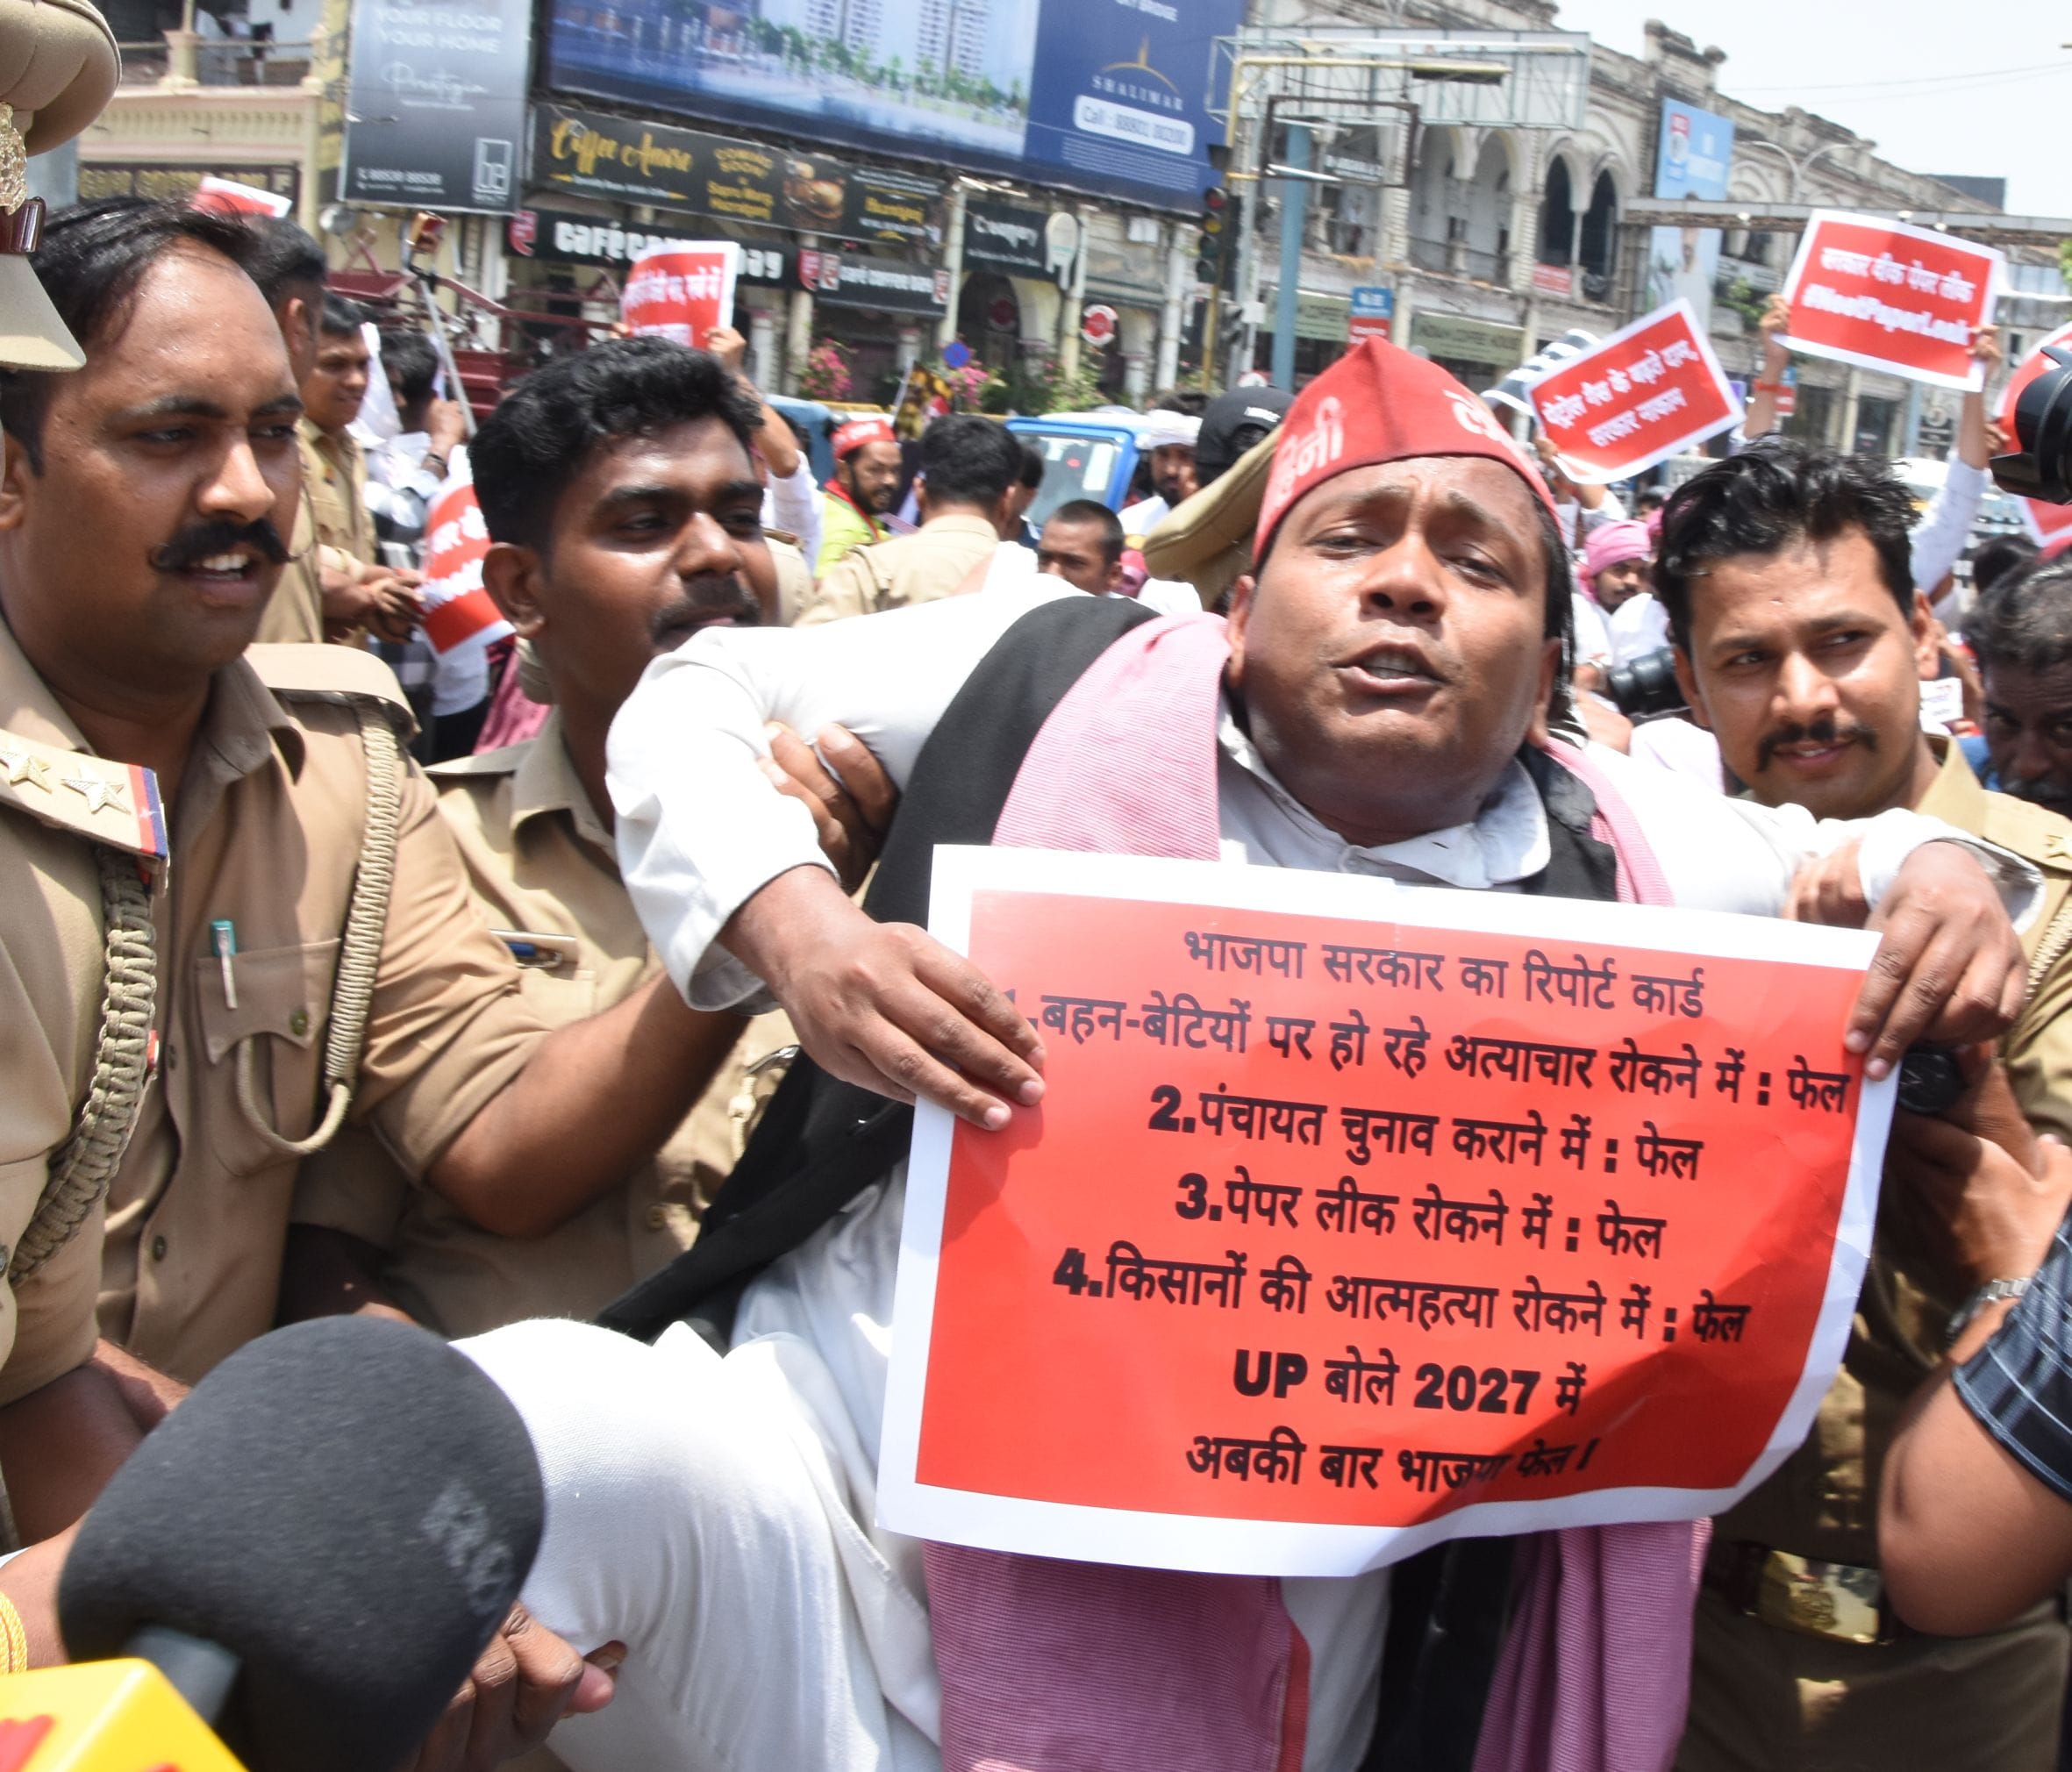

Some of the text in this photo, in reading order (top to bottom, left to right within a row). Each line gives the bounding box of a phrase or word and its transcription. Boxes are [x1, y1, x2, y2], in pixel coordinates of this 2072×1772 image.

[1091, 75, 1183, 111] SHALIMAR
[1185, 932, 1704, 1018] भाजपा सरकार का रिपोर्ट कार्ड
[1004, 988, 1852, 1112] .बहन-बेटियों पर हो रहे अत्याचार रोकने में : फेल
[1148, 1082, 1704, 1180] 2.पंचायत चुनाव कराने में : फेल
[1175, 1165, 1667, 1259] 3.पेपर लीक रोकने में : फेल
[1053, 1240, 1752, 1342] 4.किसानों की आत्महत्या रोकने में : फेल
[1233, 1346, 1586, 1416] UP बोले 2027 में
[1186, 1425, 1307, 1484] अबकी
[1320, 1445, 1383, 1489] बार
[1397, 1450, 1513, 1491] भाजपा
[1516, 1439, 1578, 1477] फेल
